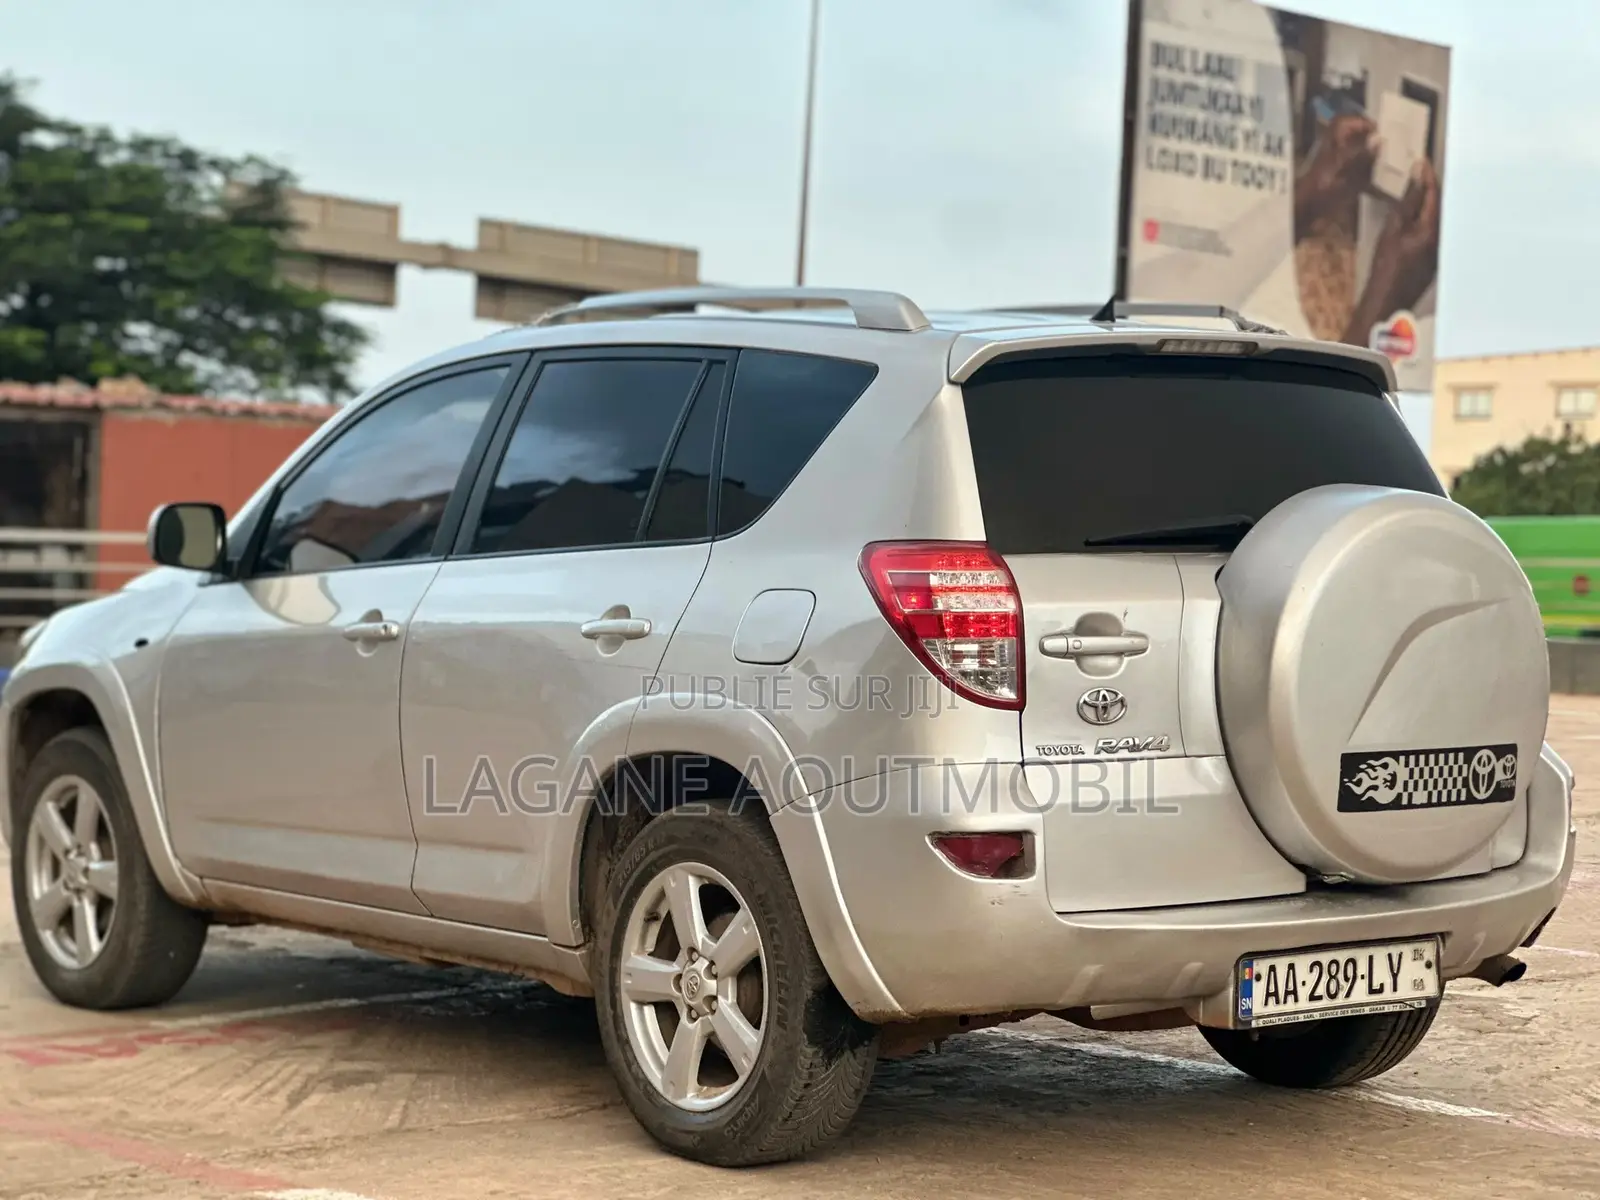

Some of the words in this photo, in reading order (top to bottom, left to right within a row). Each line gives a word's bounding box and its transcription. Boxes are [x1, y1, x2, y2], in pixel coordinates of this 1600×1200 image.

[1036, 744, 1085, 757] TOYOTA
[1093, 735, 1171, 755] RAV4
[1241, 997, 1252, 1010] SN
